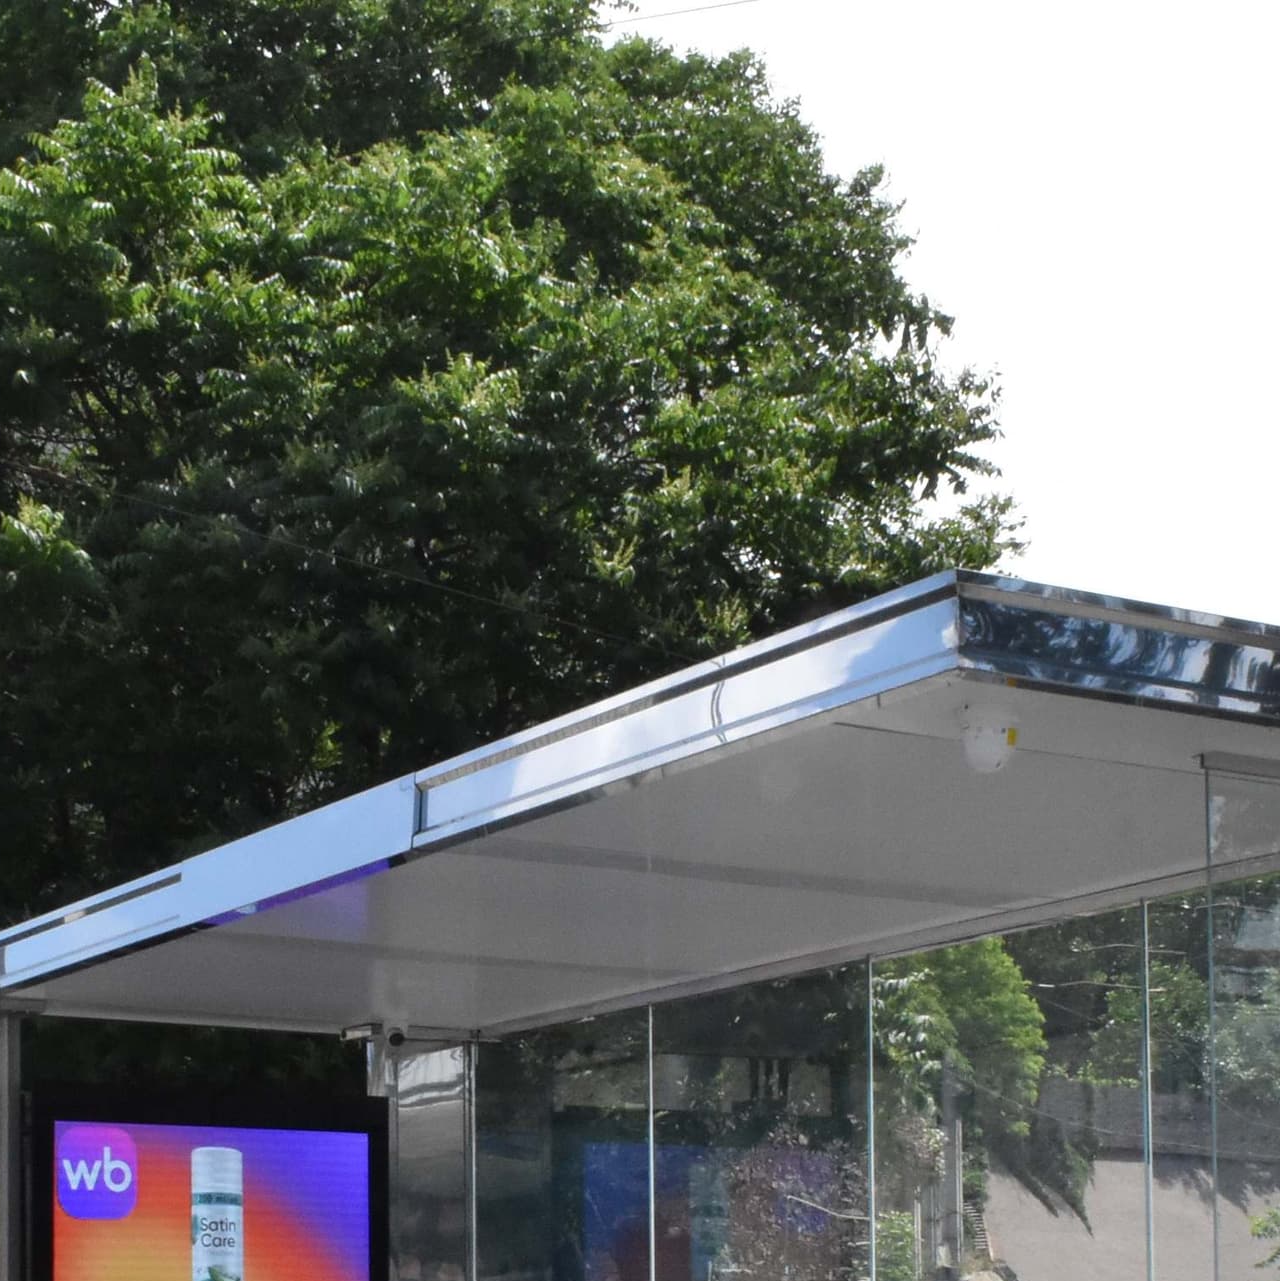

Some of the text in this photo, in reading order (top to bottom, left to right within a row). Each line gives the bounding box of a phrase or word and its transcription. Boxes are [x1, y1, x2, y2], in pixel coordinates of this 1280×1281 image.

[63, 1146, 132, 1192] wb
[200, 1217, 236, 1232] Satin
[201, 1233, 236, 1248] Care
